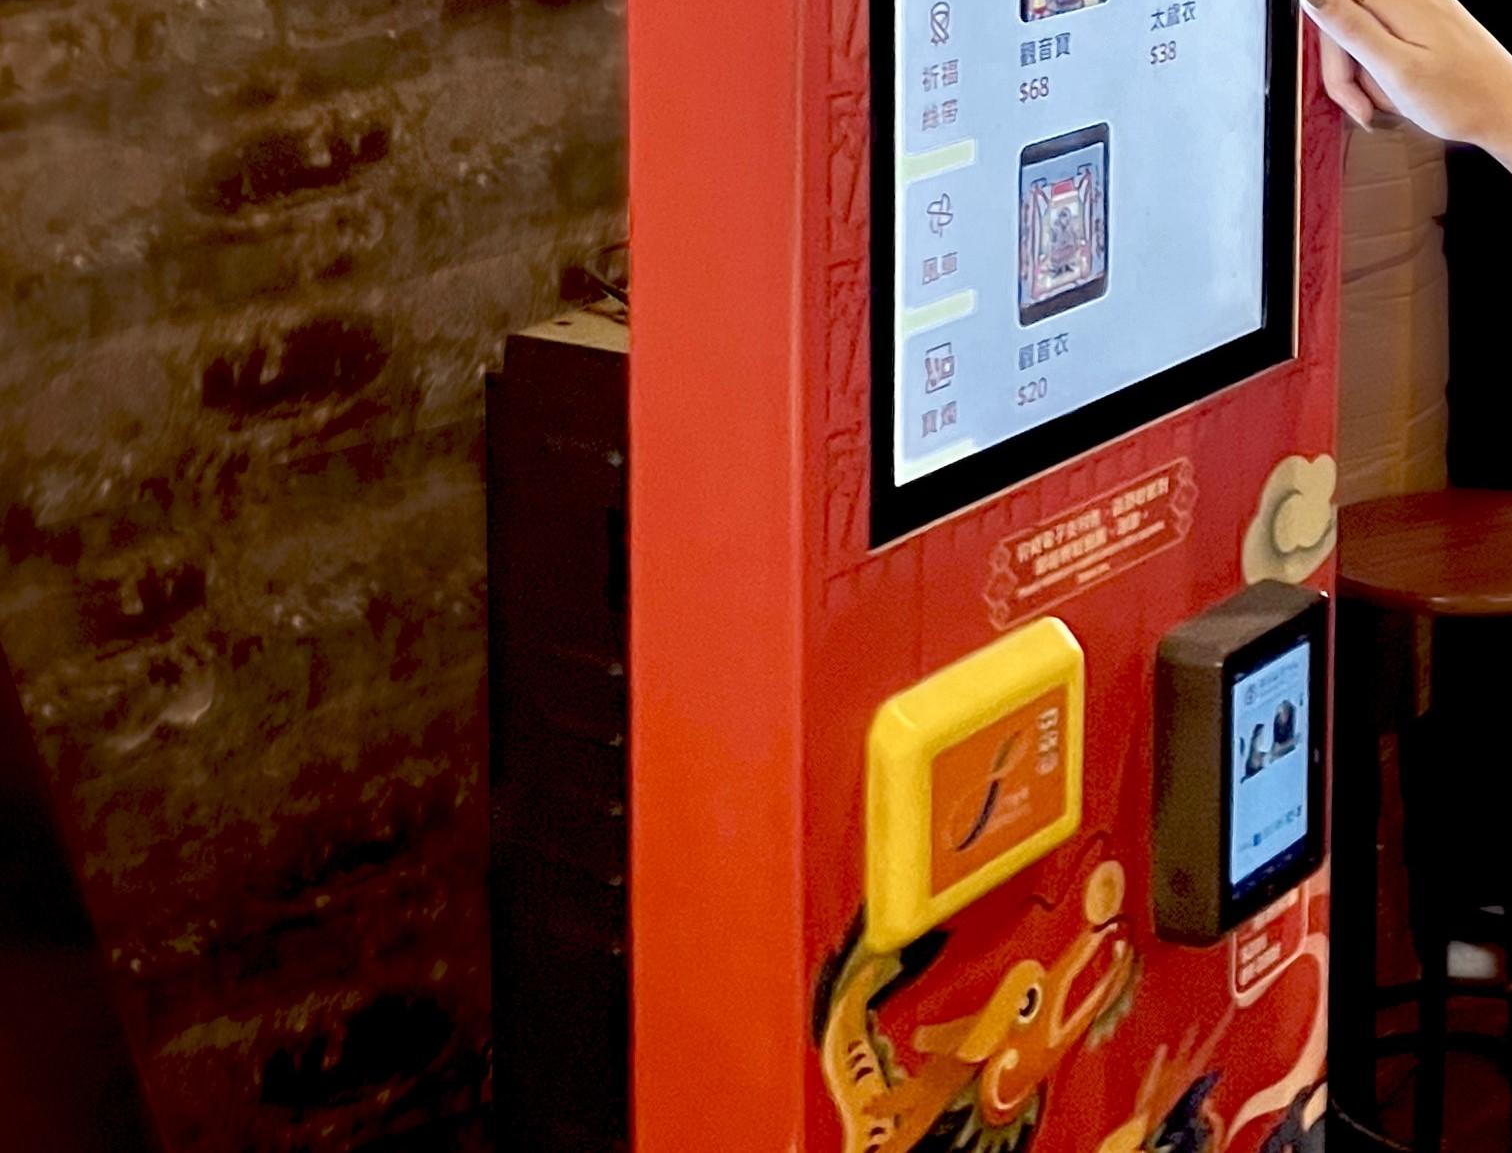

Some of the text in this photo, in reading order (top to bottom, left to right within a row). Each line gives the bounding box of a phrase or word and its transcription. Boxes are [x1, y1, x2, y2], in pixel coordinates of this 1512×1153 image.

[1150, 40, 1177, 65] $38
[1019, 76, 1049, 103] $68
[1017, 376, 1048, 406] $20
